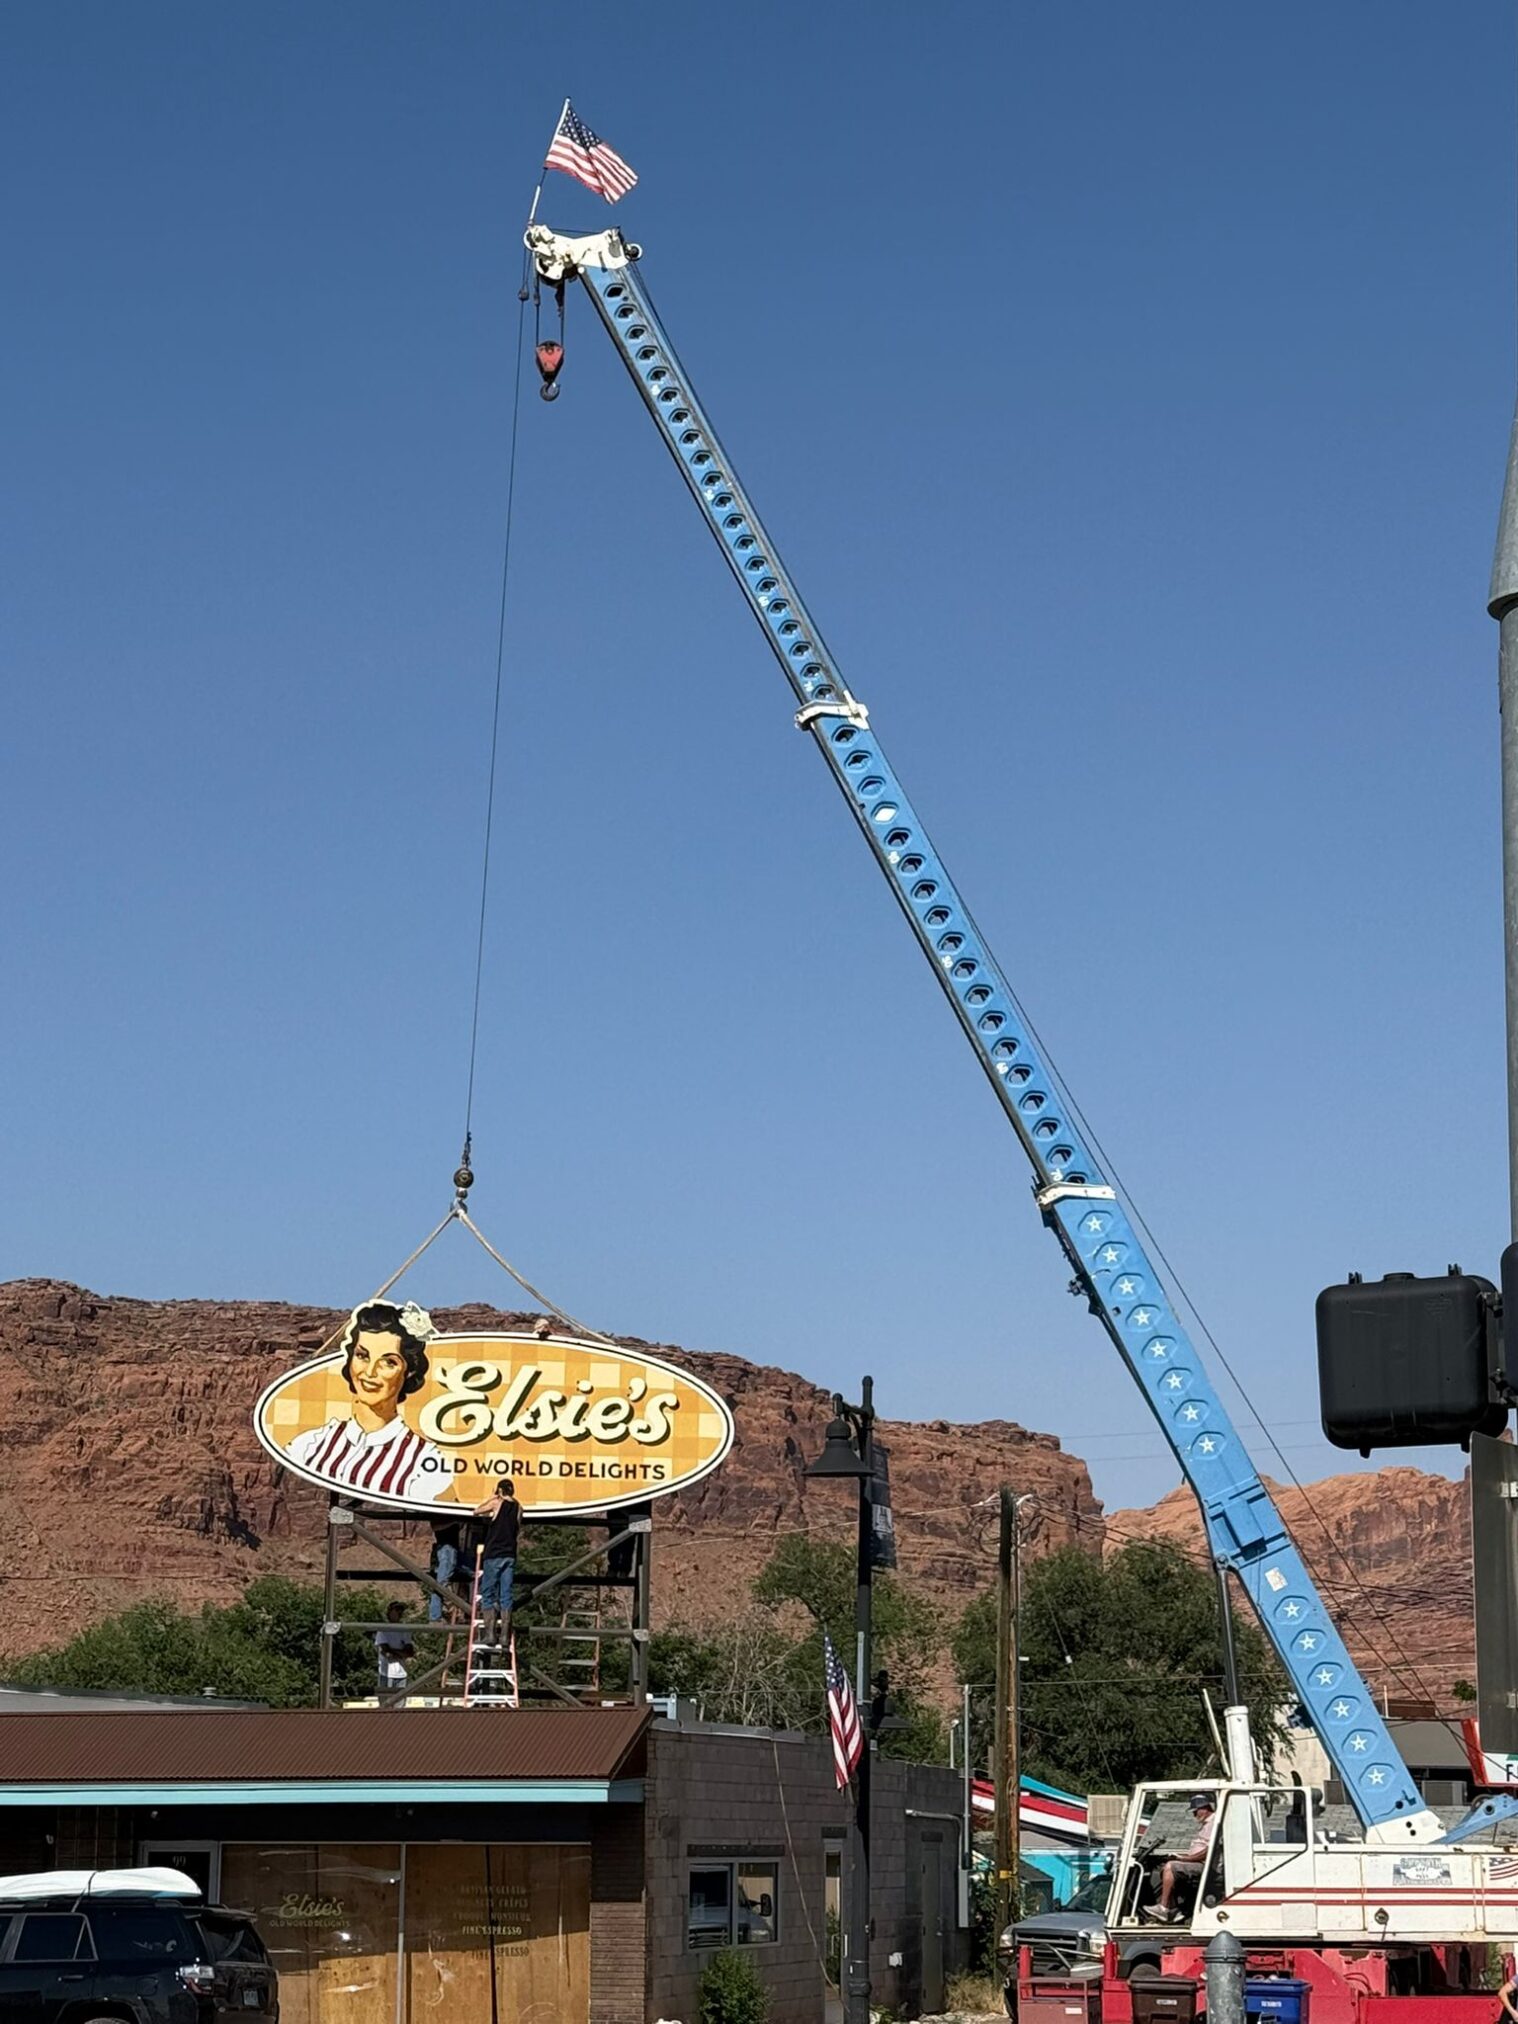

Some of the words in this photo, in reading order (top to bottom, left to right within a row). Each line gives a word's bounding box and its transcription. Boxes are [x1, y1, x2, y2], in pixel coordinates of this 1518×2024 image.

[418, 1360, 680, 1447] Elsie's
[421, 1456, 468, 1474] OLD
[474, 1458, 553, 1477] WORLD
[559, 1460, 666, 1480] DELIGHTS
[279, 1893, 345, 1918] Elsie's
